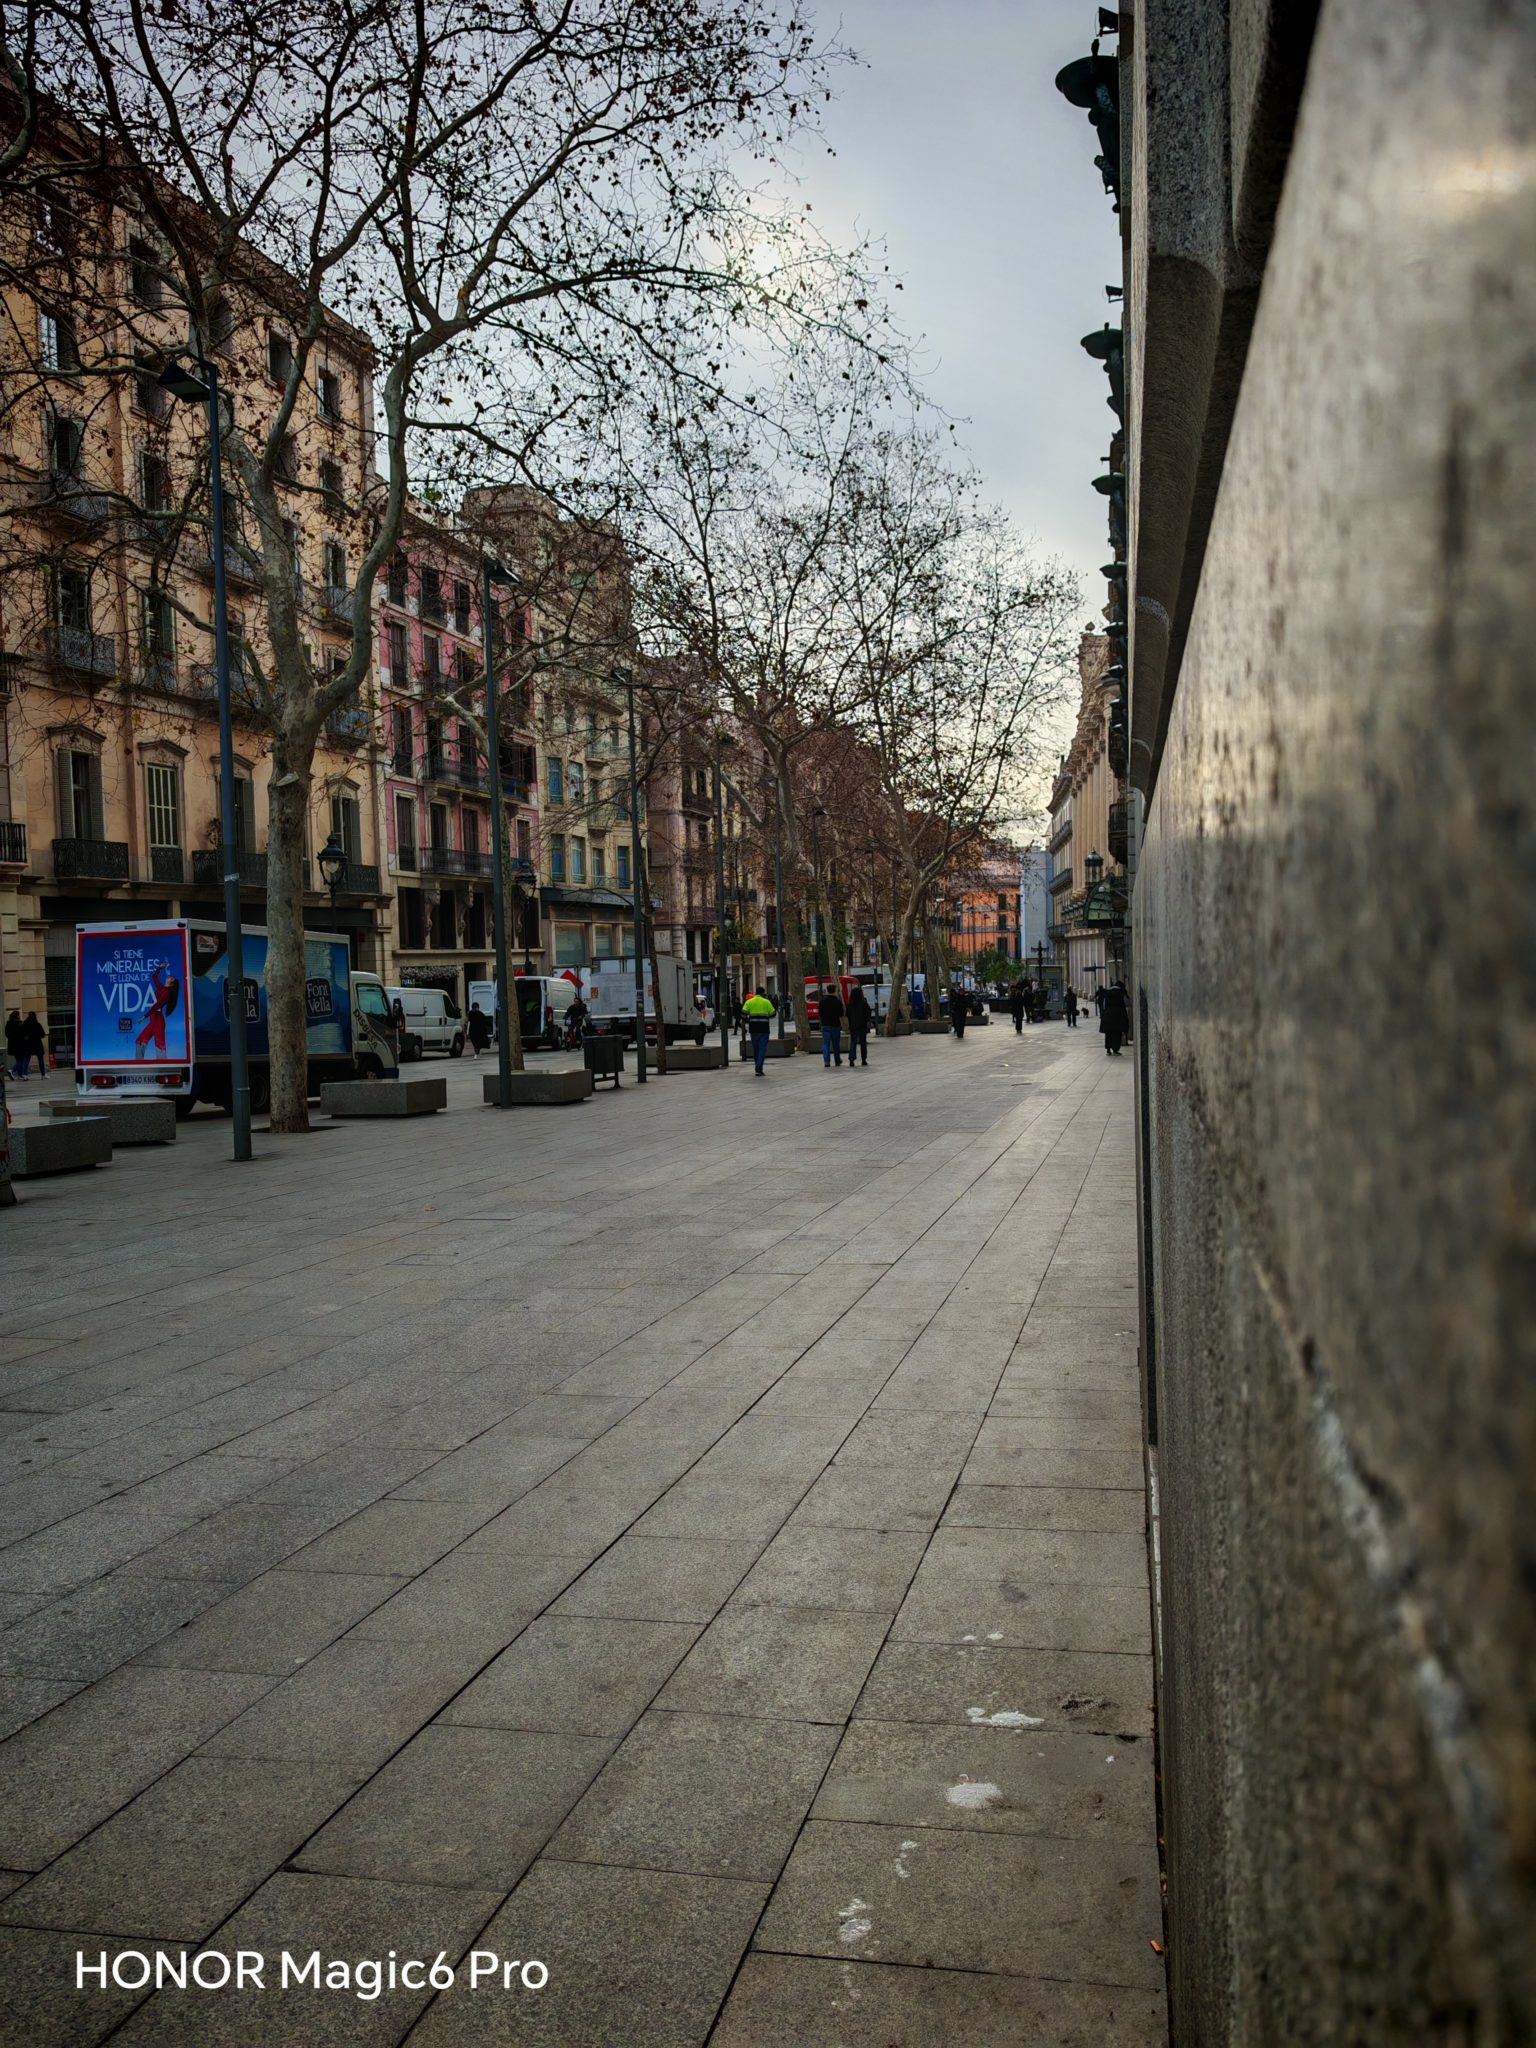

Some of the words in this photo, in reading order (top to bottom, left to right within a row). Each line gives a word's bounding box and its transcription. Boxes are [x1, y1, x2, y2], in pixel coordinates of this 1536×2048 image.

[113, 950, 120, 960] SI
[122, 949, 143, 959] TIENE
[97, 959, 160, 973] MINERALES
[109, 974, 117, 982] TE
[117, 974, 139, 982] LLENA
[140, 973, 151, 982] DE
[98, 983, 157, 1012] VIDA
[306, 983, 329, 999] Font
[307, 996, 332, 1014] Vella
